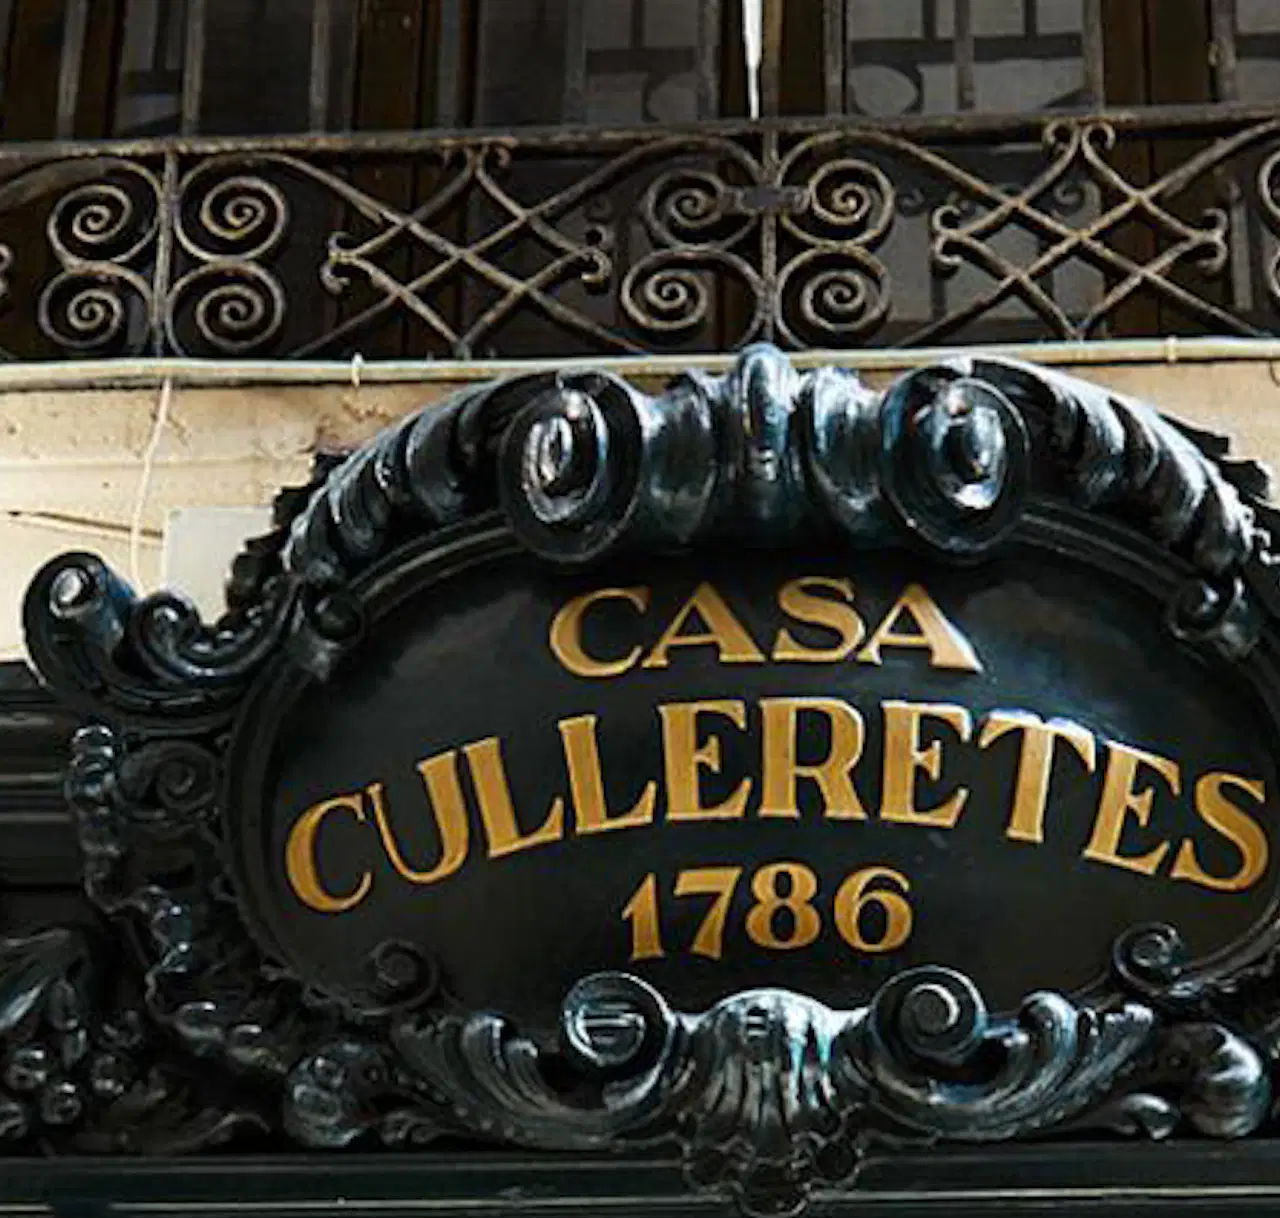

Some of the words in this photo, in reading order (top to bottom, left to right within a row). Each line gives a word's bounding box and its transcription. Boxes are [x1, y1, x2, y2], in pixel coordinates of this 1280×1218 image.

[549, 577, 984, 677] CASA
[285, 696, 1269, 914] CULLERETES
[622, 862, 913, 960] 1786
